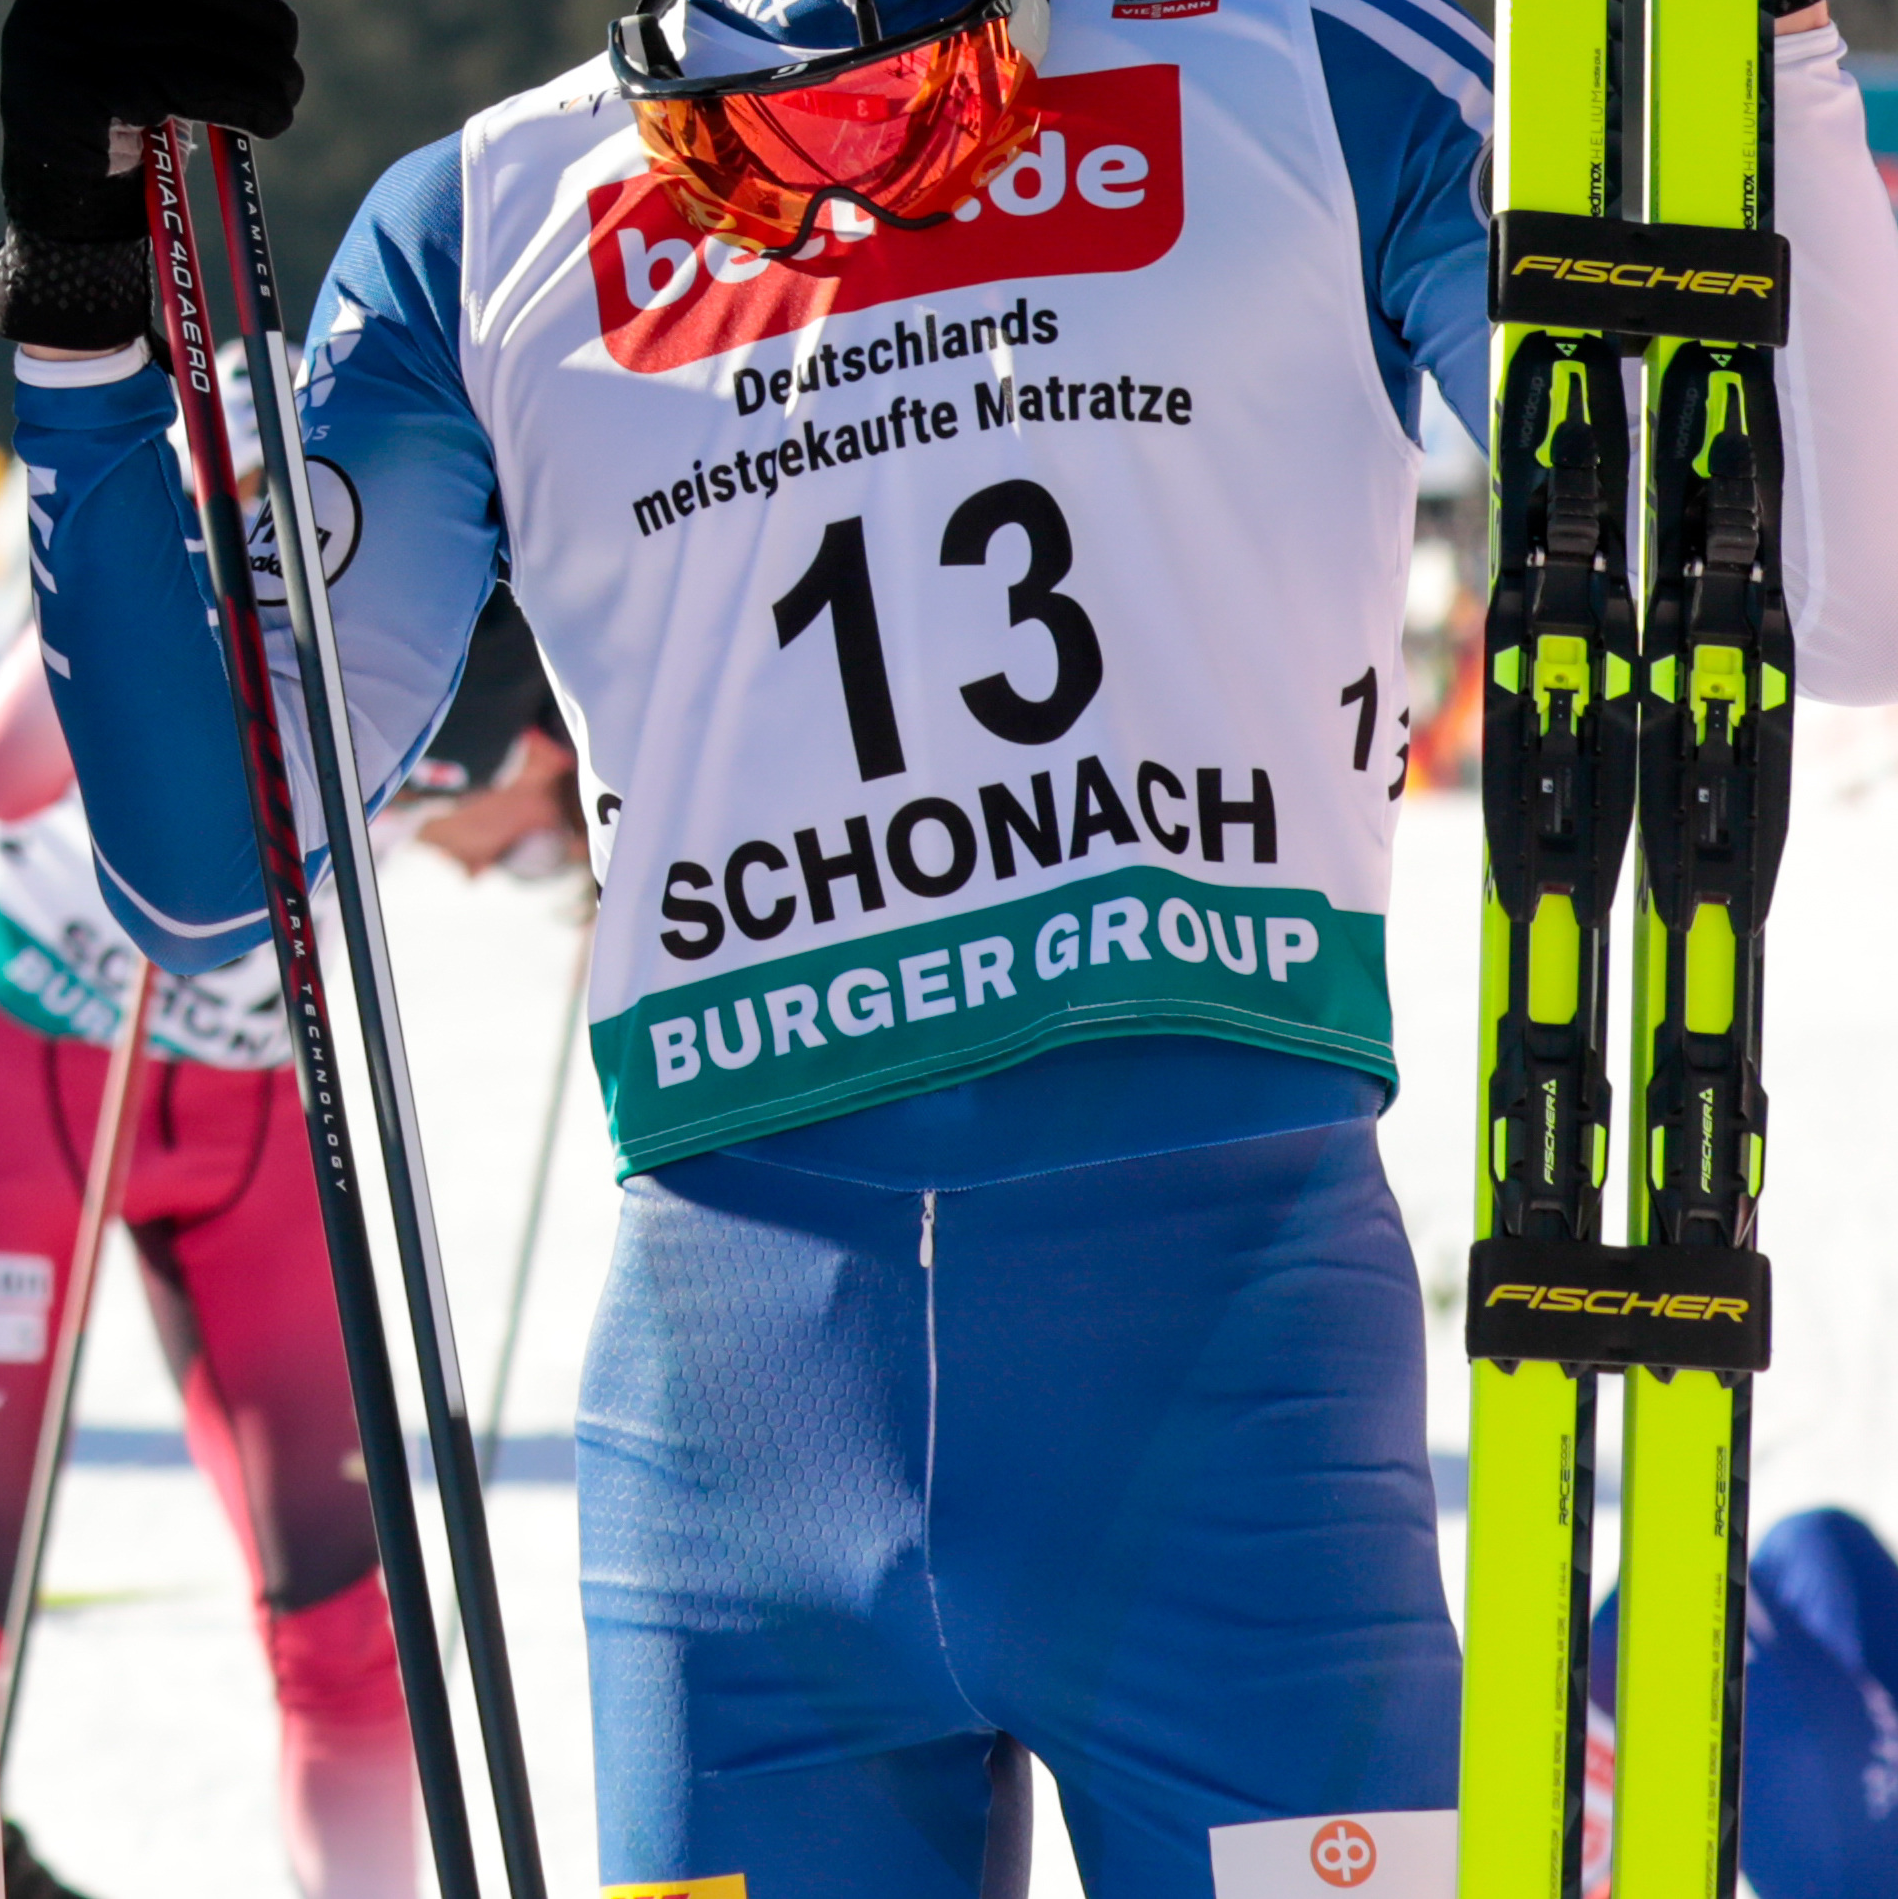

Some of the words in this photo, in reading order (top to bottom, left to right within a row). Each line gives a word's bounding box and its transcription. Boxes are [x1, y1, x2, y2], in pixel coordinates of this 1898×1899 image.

[1590, 89, 1603, 159] HELIUM
[1743, 102, 1756, 171] HELIUM
[150, 131, 184, 236] TRIAC
[237, 137, 271, 298] DYNAMICS
[168, 240, 193, 290] 4.0
[1511, 254, 1774, 299] FISCHER
[179, 294, 212, 394] AERO
[734, 298, 1060, 416] Deutschlands
[631, 394, 960, 539] meistgekaufte
[974, 374, 1194, 434] Matratze
[772, 479, 1103, 782] 13
[659, 756, 1278, 960] SCHONACH
[650, 936, 1016, 1089] BURGER
[1034, 896, 1320, 984] GROUP
[301, 982, 348, 1193] TECHNOLOGY
[1542, 1103, 1556, 1185] FISCHER
[1700, 1104, 1714, 1194] FISCHER
[1485, 1283, 1748, 1322] FISCHER
